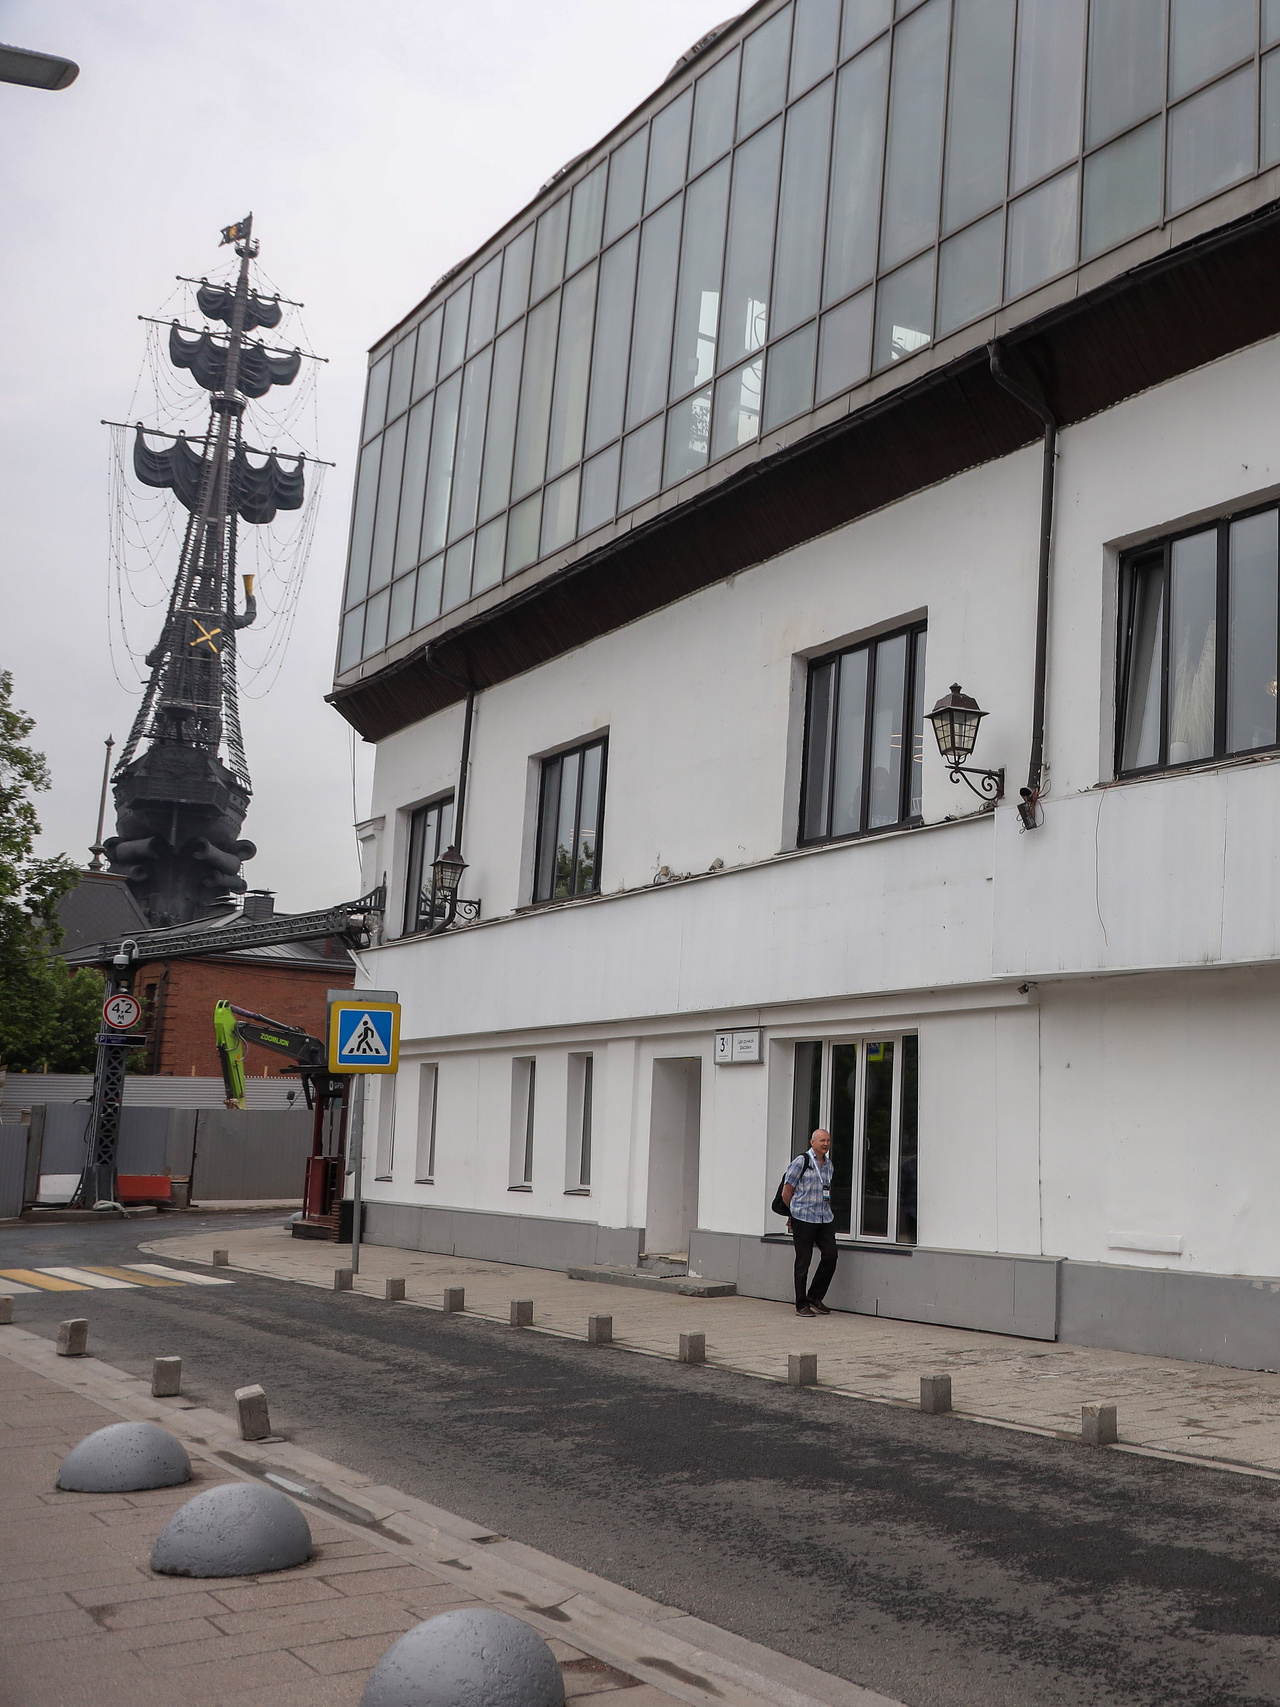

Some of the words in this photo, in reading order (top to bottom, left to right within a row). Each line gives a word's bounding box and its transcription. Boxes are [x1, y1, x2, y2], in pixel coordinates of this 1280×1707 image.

[112, 1003, 132, 1015] 4,2
[260, 1032, 290, 1047] ZOOMLION
[720, 1037, 725, 1052] 3
